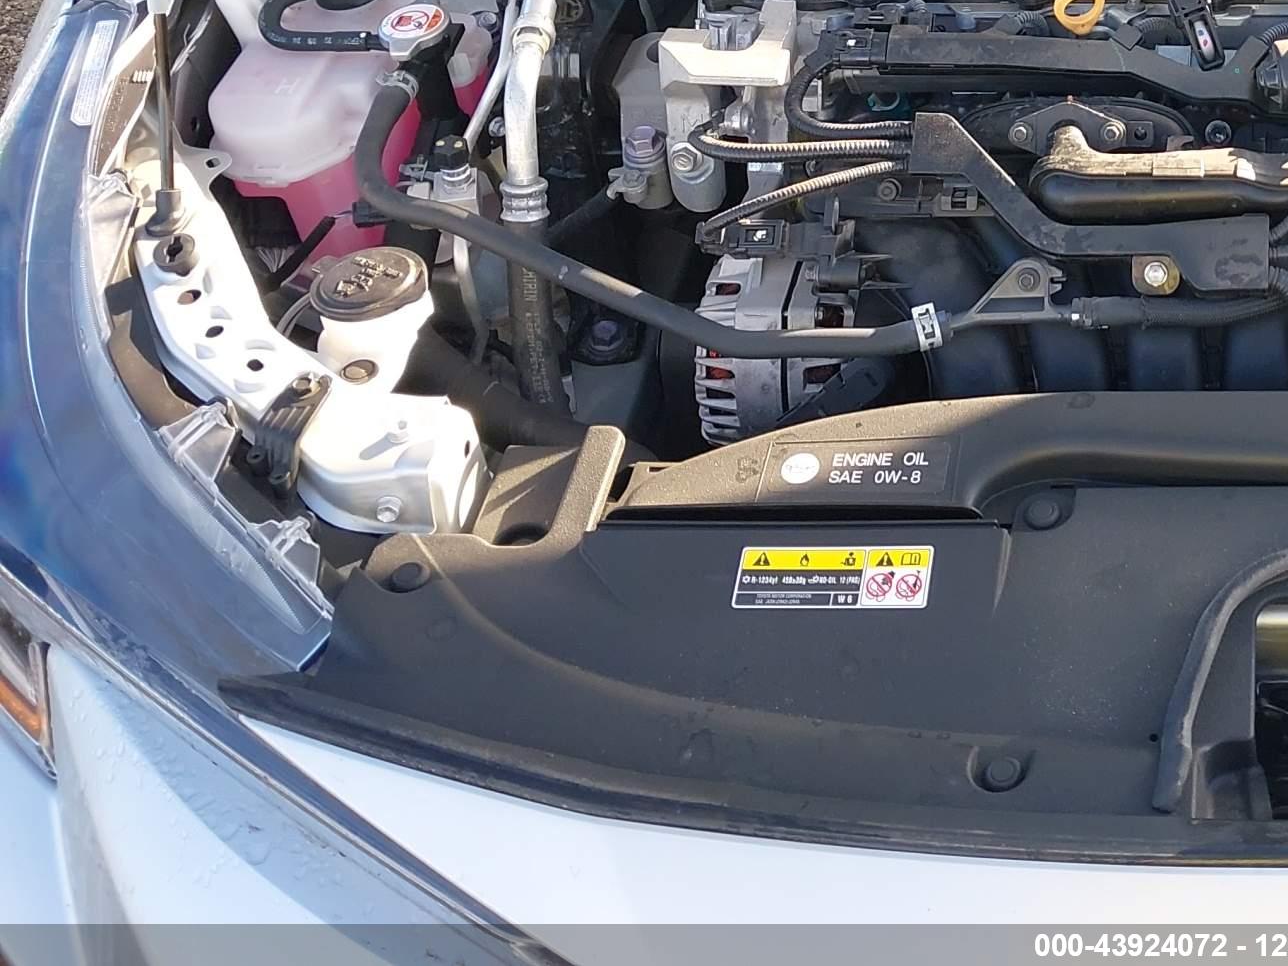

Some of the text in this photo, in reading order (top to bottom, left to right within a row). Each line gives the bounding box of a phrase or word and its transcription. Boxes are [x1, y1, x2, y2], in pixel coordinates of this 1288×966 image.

[832, 452, 929, 467] ENGINE OIL
[828, 470, 921, 484] SAE 0W-8
